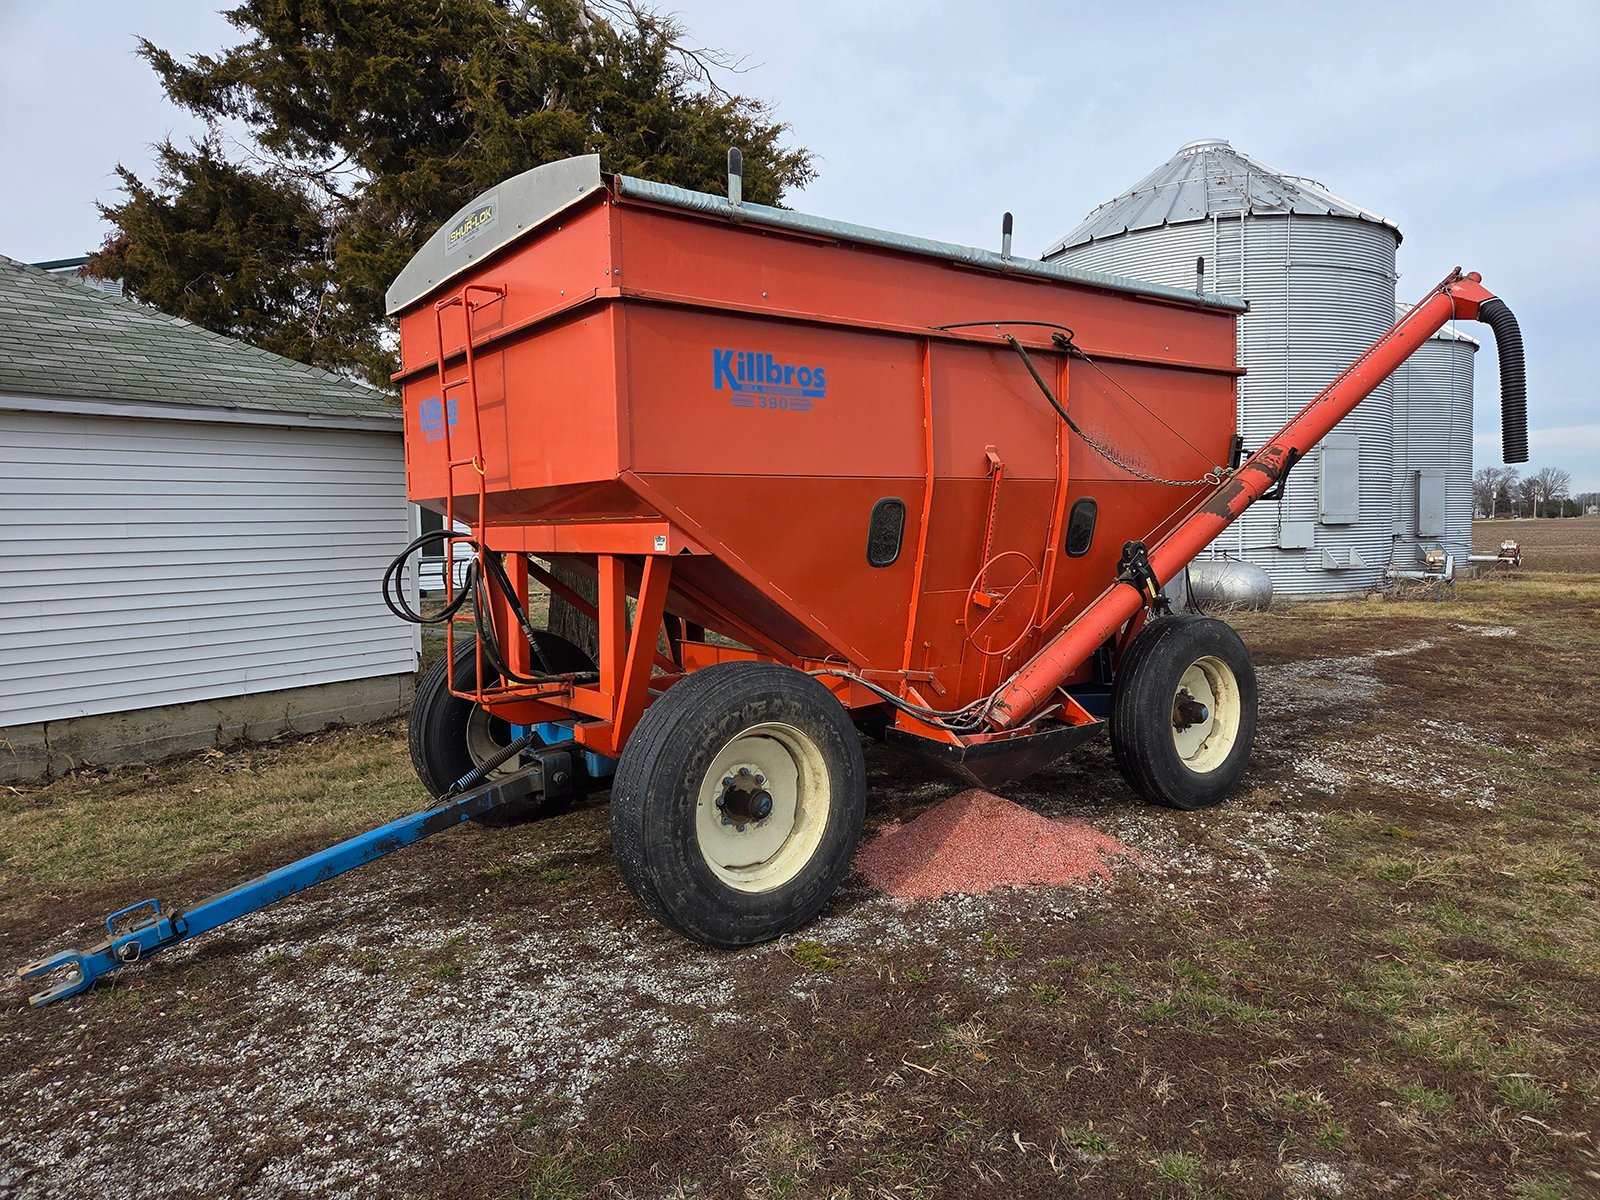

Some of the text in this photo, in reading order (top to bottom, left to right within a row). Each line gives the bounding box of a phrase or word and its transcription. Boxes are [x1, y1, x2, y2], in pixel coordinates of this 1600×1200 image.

[450, 206, 492, 243] SHUR-LOK
[713, 348, 826, 391] Killbros
[758, 396, 788, 410] 390
